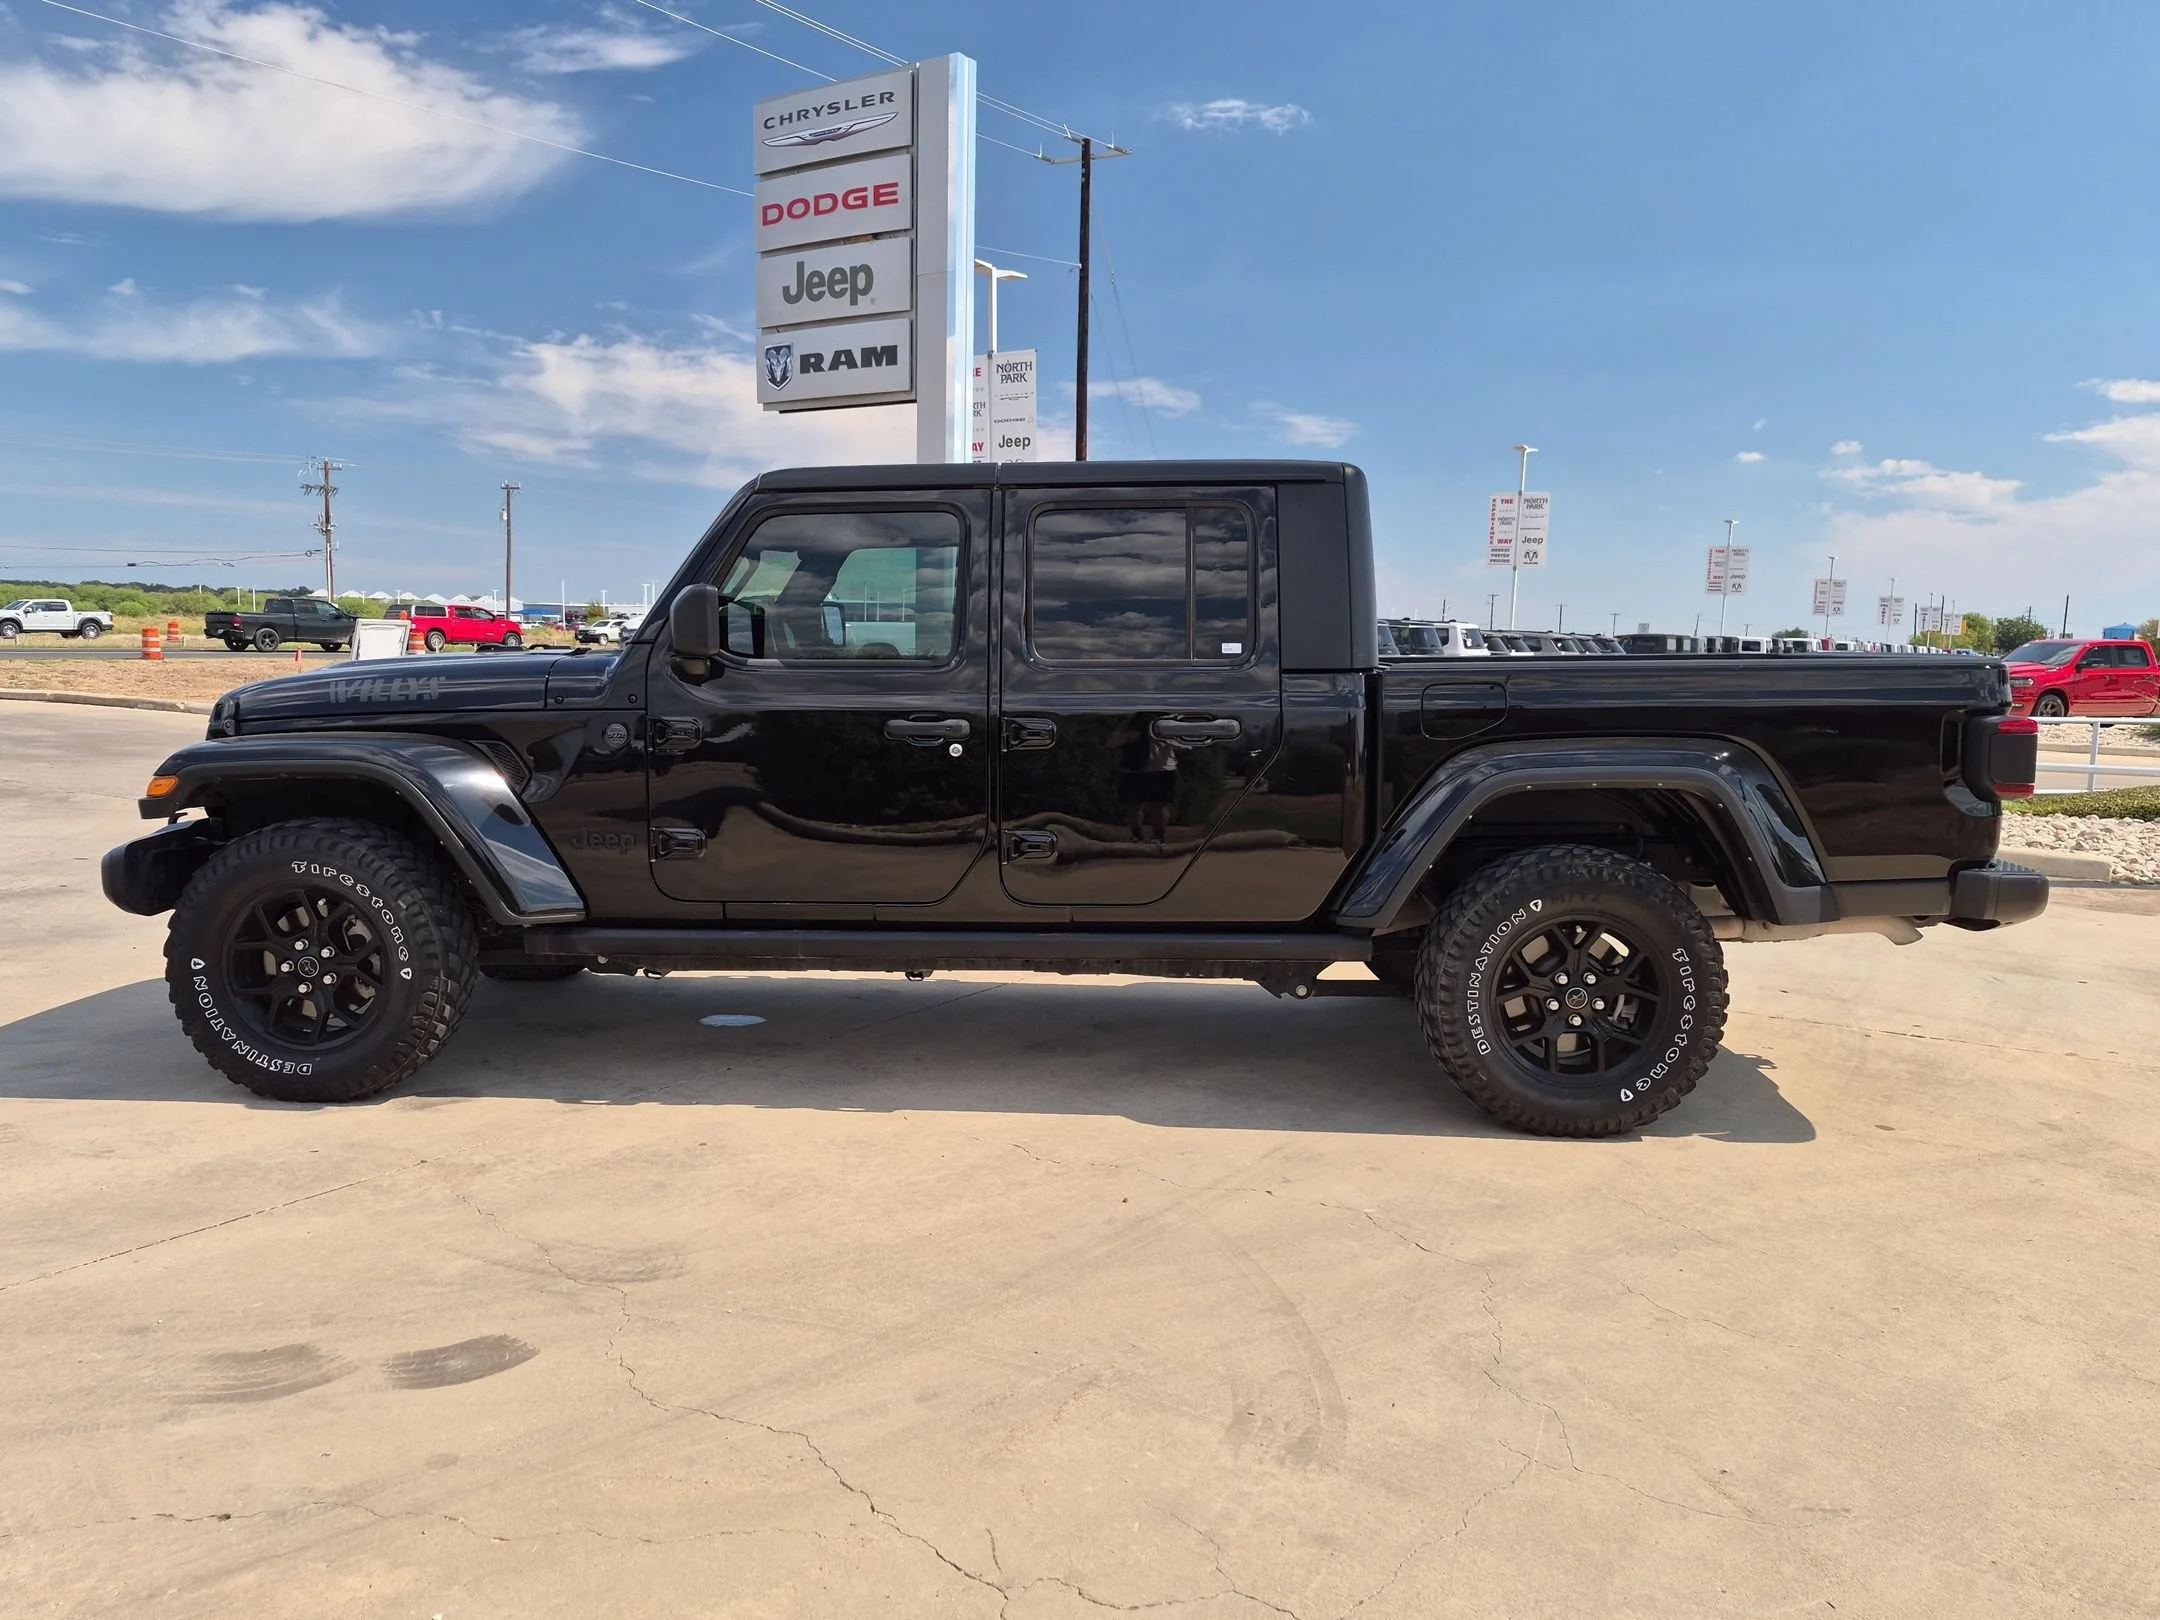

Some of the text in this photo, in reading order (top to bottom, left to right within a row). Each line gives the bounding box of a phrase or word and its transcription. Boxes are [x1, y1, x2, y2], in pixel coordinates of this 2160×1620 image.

[763, 91, 895, 130] CHRYSLER
[762, 182, 899, 227] DODGE
[782, 261, 874, 306] Jeep
[800, 345, 898, 374] RAM
[996, 360, 1033, 374] NORTH
[1000, 372, 1028, 384] PARK
[971, 442, 985, 452] AY
[998, 434, 1031, 450] Jeep
[1521, 536, 1544, 546] Jeep
[571, 827, 637, 855] Jeep
[291, 860, 409, 962] Firestone
[1467, 908, 1527, 1056] DESTINATION
[192, 975, 313, 1076] DESTINATION
[1635, 947, 1697, 1092] Firestone
